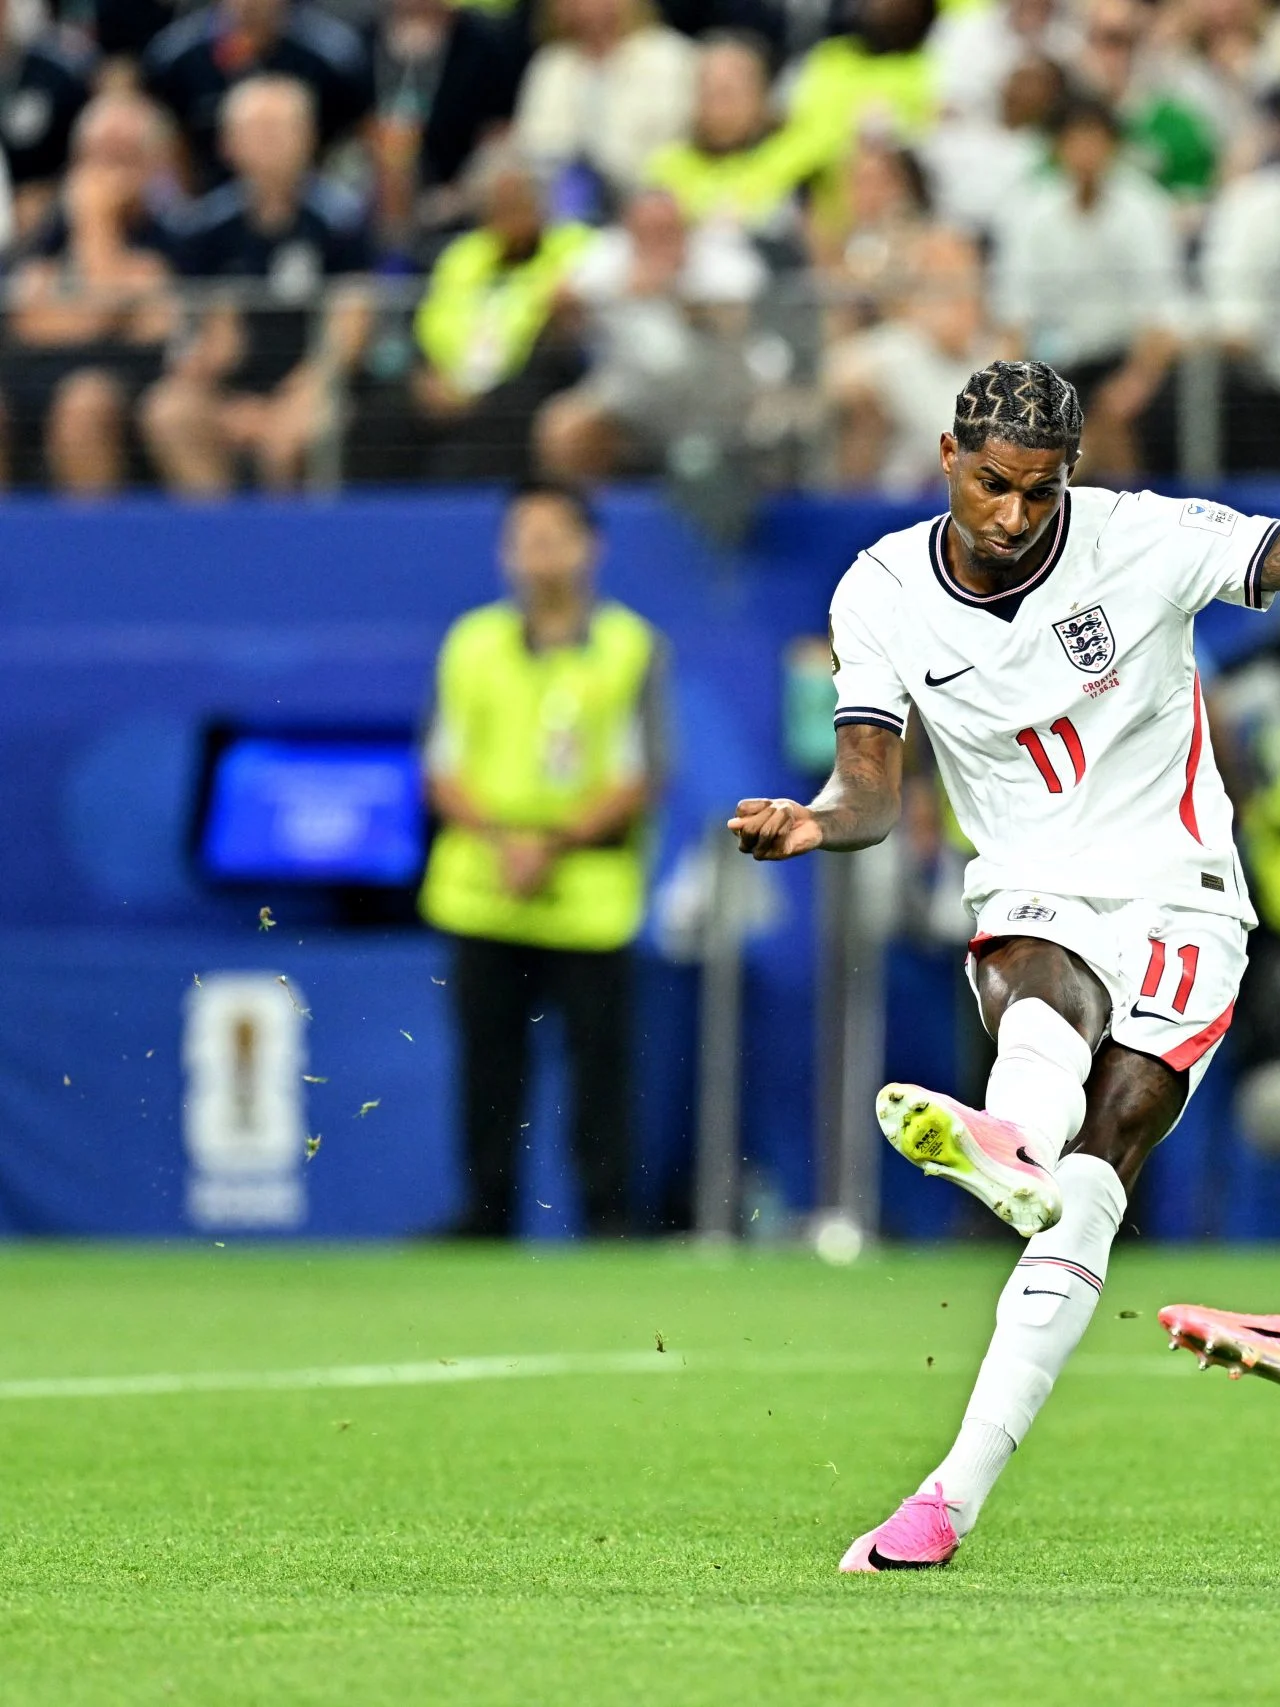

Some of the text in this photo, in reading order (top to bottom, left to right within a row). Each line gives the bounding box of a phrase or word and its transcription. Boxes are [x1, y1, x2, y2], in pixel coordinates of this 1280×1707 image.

[1082, 668, 1118, 693] CROATIA
[1015, 716, 1086, 793] 11
[1140, 937, 1200, 1015] 11
[920, 1130, 940, 1154] ZOOM
